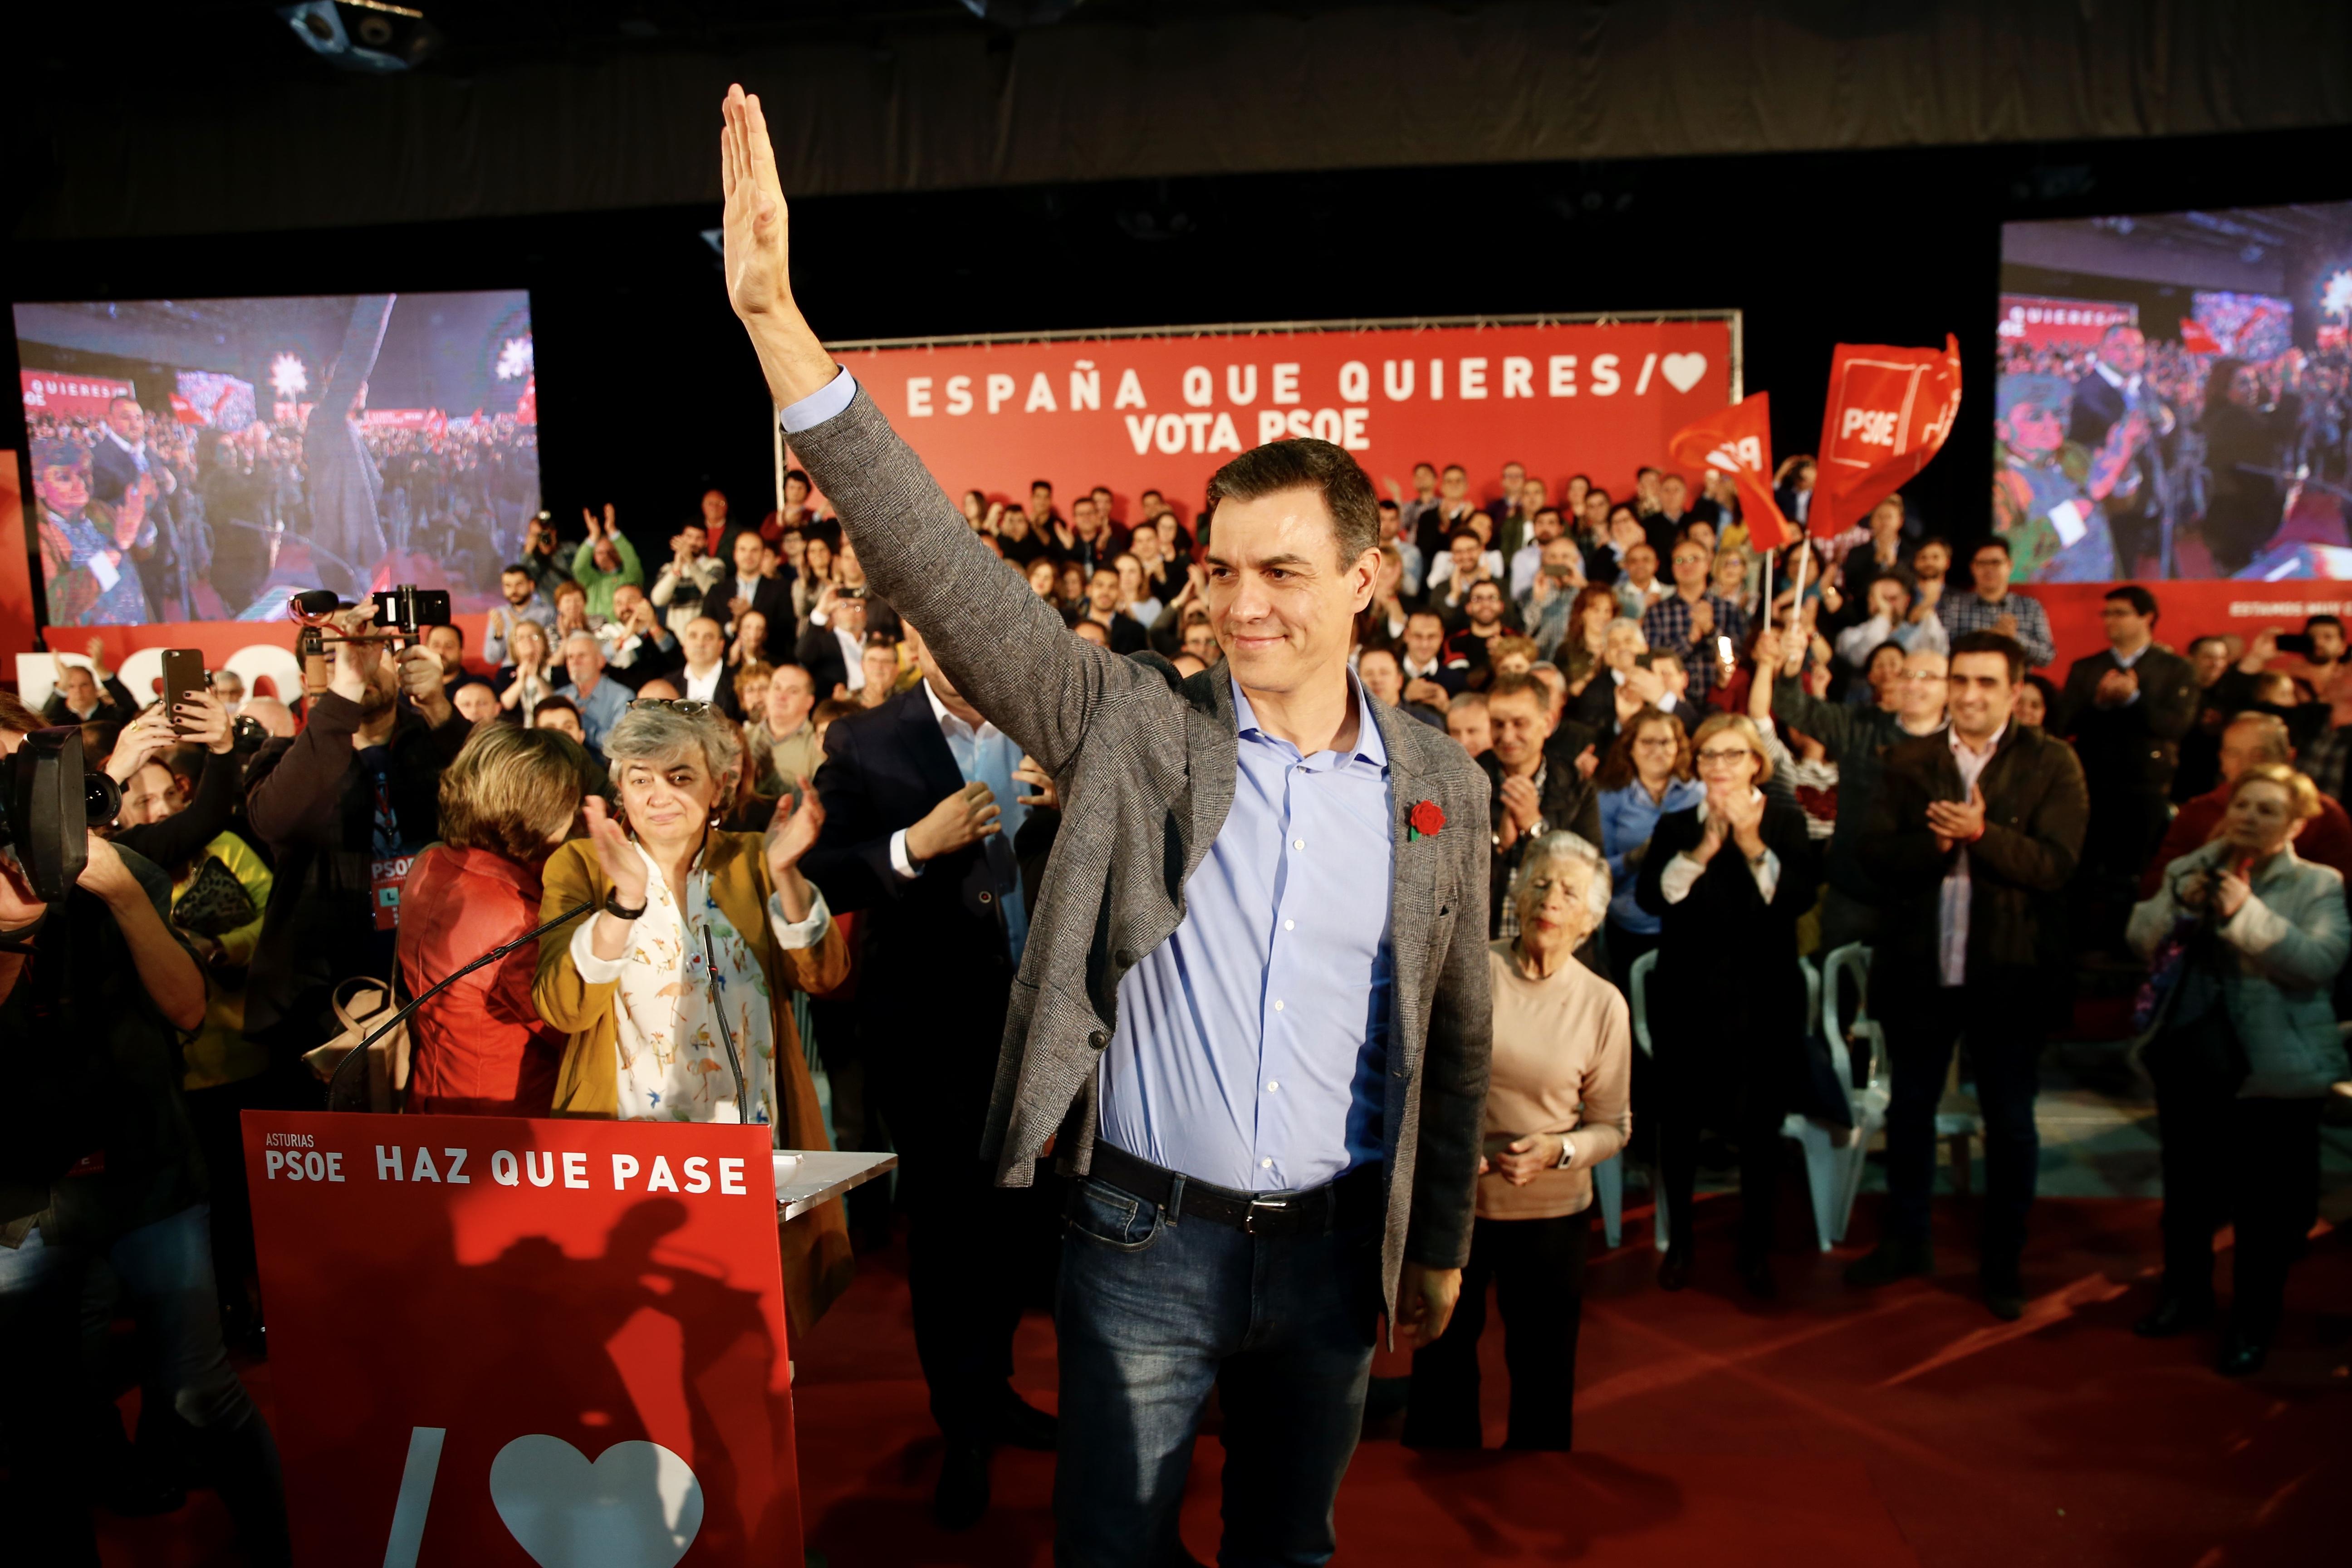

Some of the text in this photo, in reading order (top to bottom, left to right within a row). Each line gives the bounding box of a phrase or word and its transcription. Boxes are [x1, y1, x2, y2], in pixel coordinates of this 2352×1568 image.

[905, 358, 1148, 419] ESPAÑA
[1182, 362, 1301, 408] QUE
[1124, 407, 1370, 456] VOTA PSOE
[266, 1133, 314, 1148] ASTURIAS
[265, 1150, 345, 1182] PSOE
[375, 1145, 747, 1196] HAZ QUE PASE
